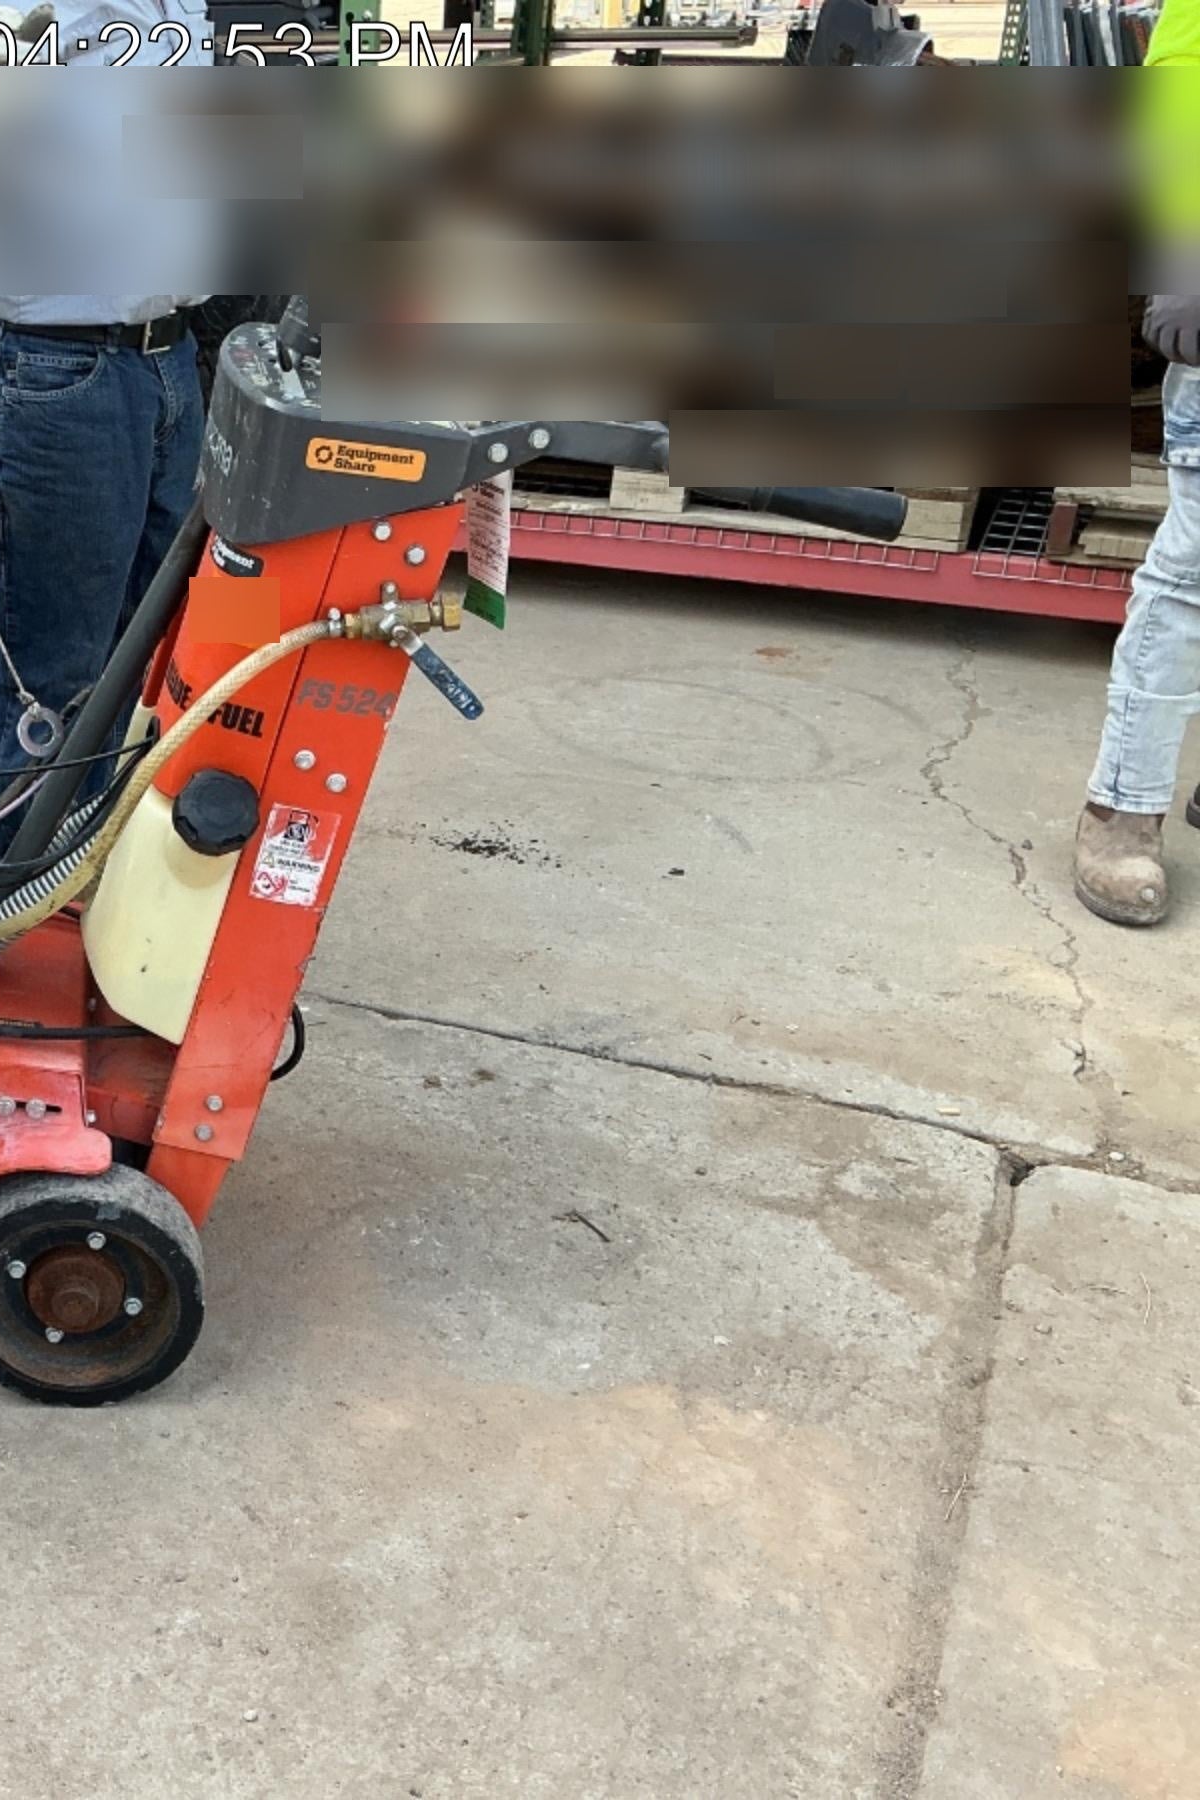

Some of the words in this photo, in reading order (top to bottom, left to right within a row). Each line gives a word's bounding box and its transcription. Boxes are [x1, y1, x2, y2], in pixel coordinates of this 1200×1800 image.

[333, 457, 376, 473] Share
[336, 445, 415, 465] Equipment
[297, 678, 336, 710] FS
[336, 684, 398, 720] 524
